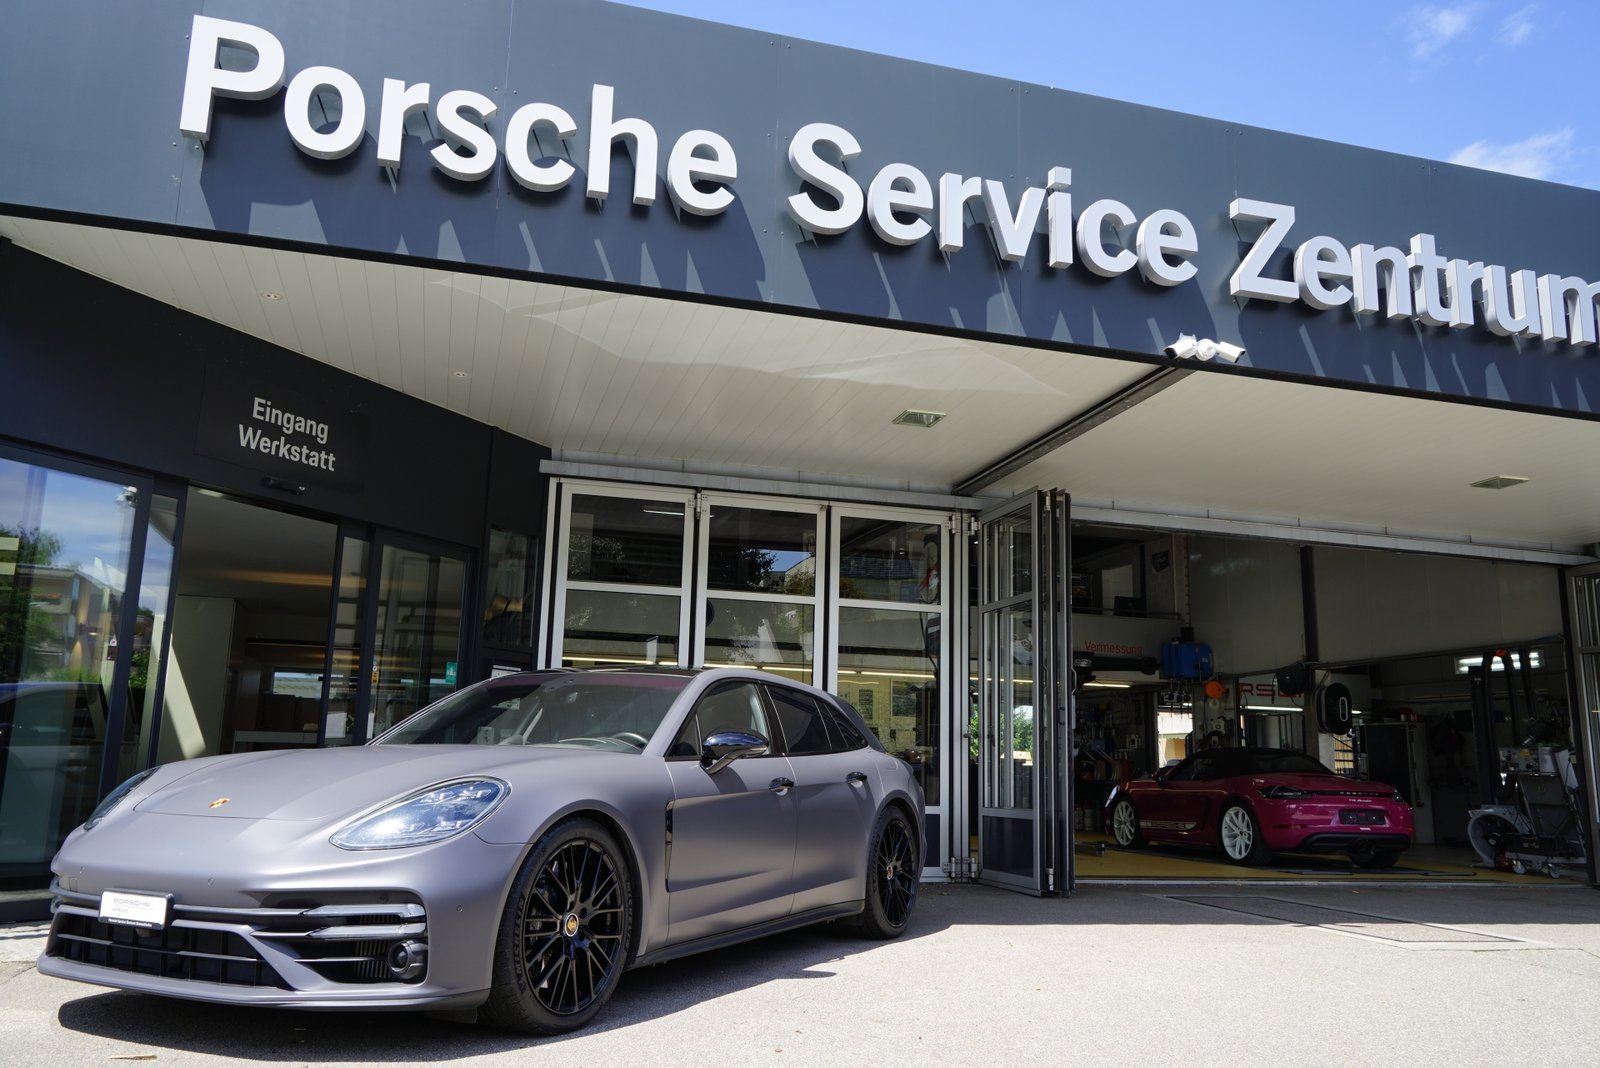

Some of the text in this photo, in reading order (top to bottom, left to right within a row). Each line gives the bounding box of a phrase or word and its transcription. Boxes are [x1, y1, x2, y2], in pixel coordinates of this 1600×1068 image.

[179, 14, 738, 217] Porsche
[787, 122, 1199, 287] Service
[252, 396, 329, 445] Eingang
[238, 423, 336, 472] Werkstatt
[1084, 640, 1143, 656] Vermessung
[514, 897, 524, 974] MICHELIN
